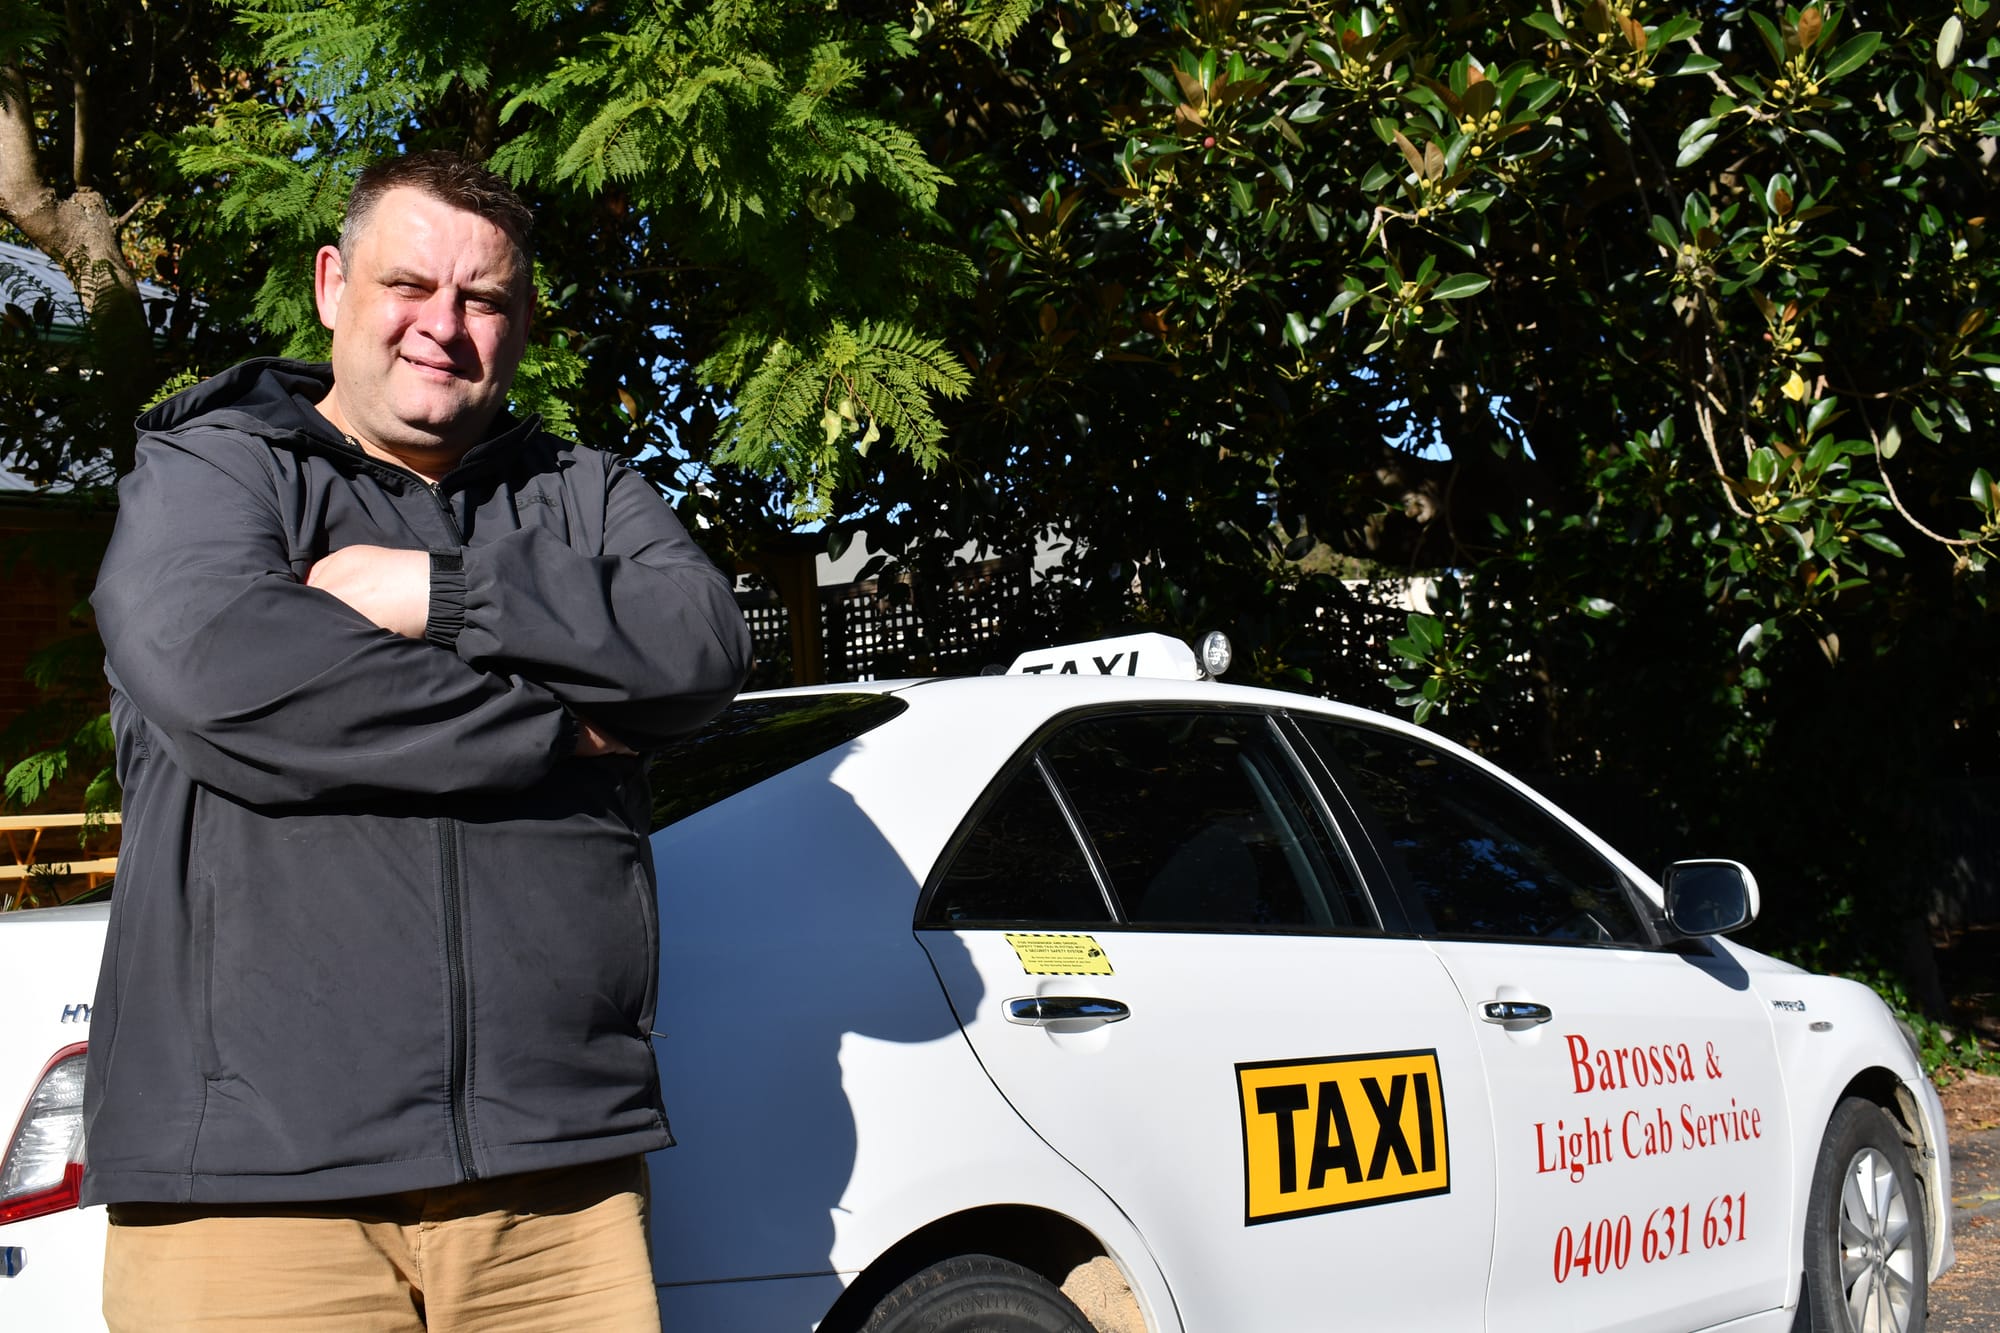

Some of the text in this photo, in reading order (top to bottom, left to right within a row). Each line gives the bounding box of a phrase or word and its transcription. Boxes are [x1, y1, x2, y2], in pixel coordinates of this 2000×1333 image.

[1563, 1034, 1722, 1094] Barossa &
[1255, 1072, 1436, 1194] TAXI
[1533, 1097, 1761, 1184] Light Cab Service
[1553, 1191, 1747, 1284] 0400 631 631
